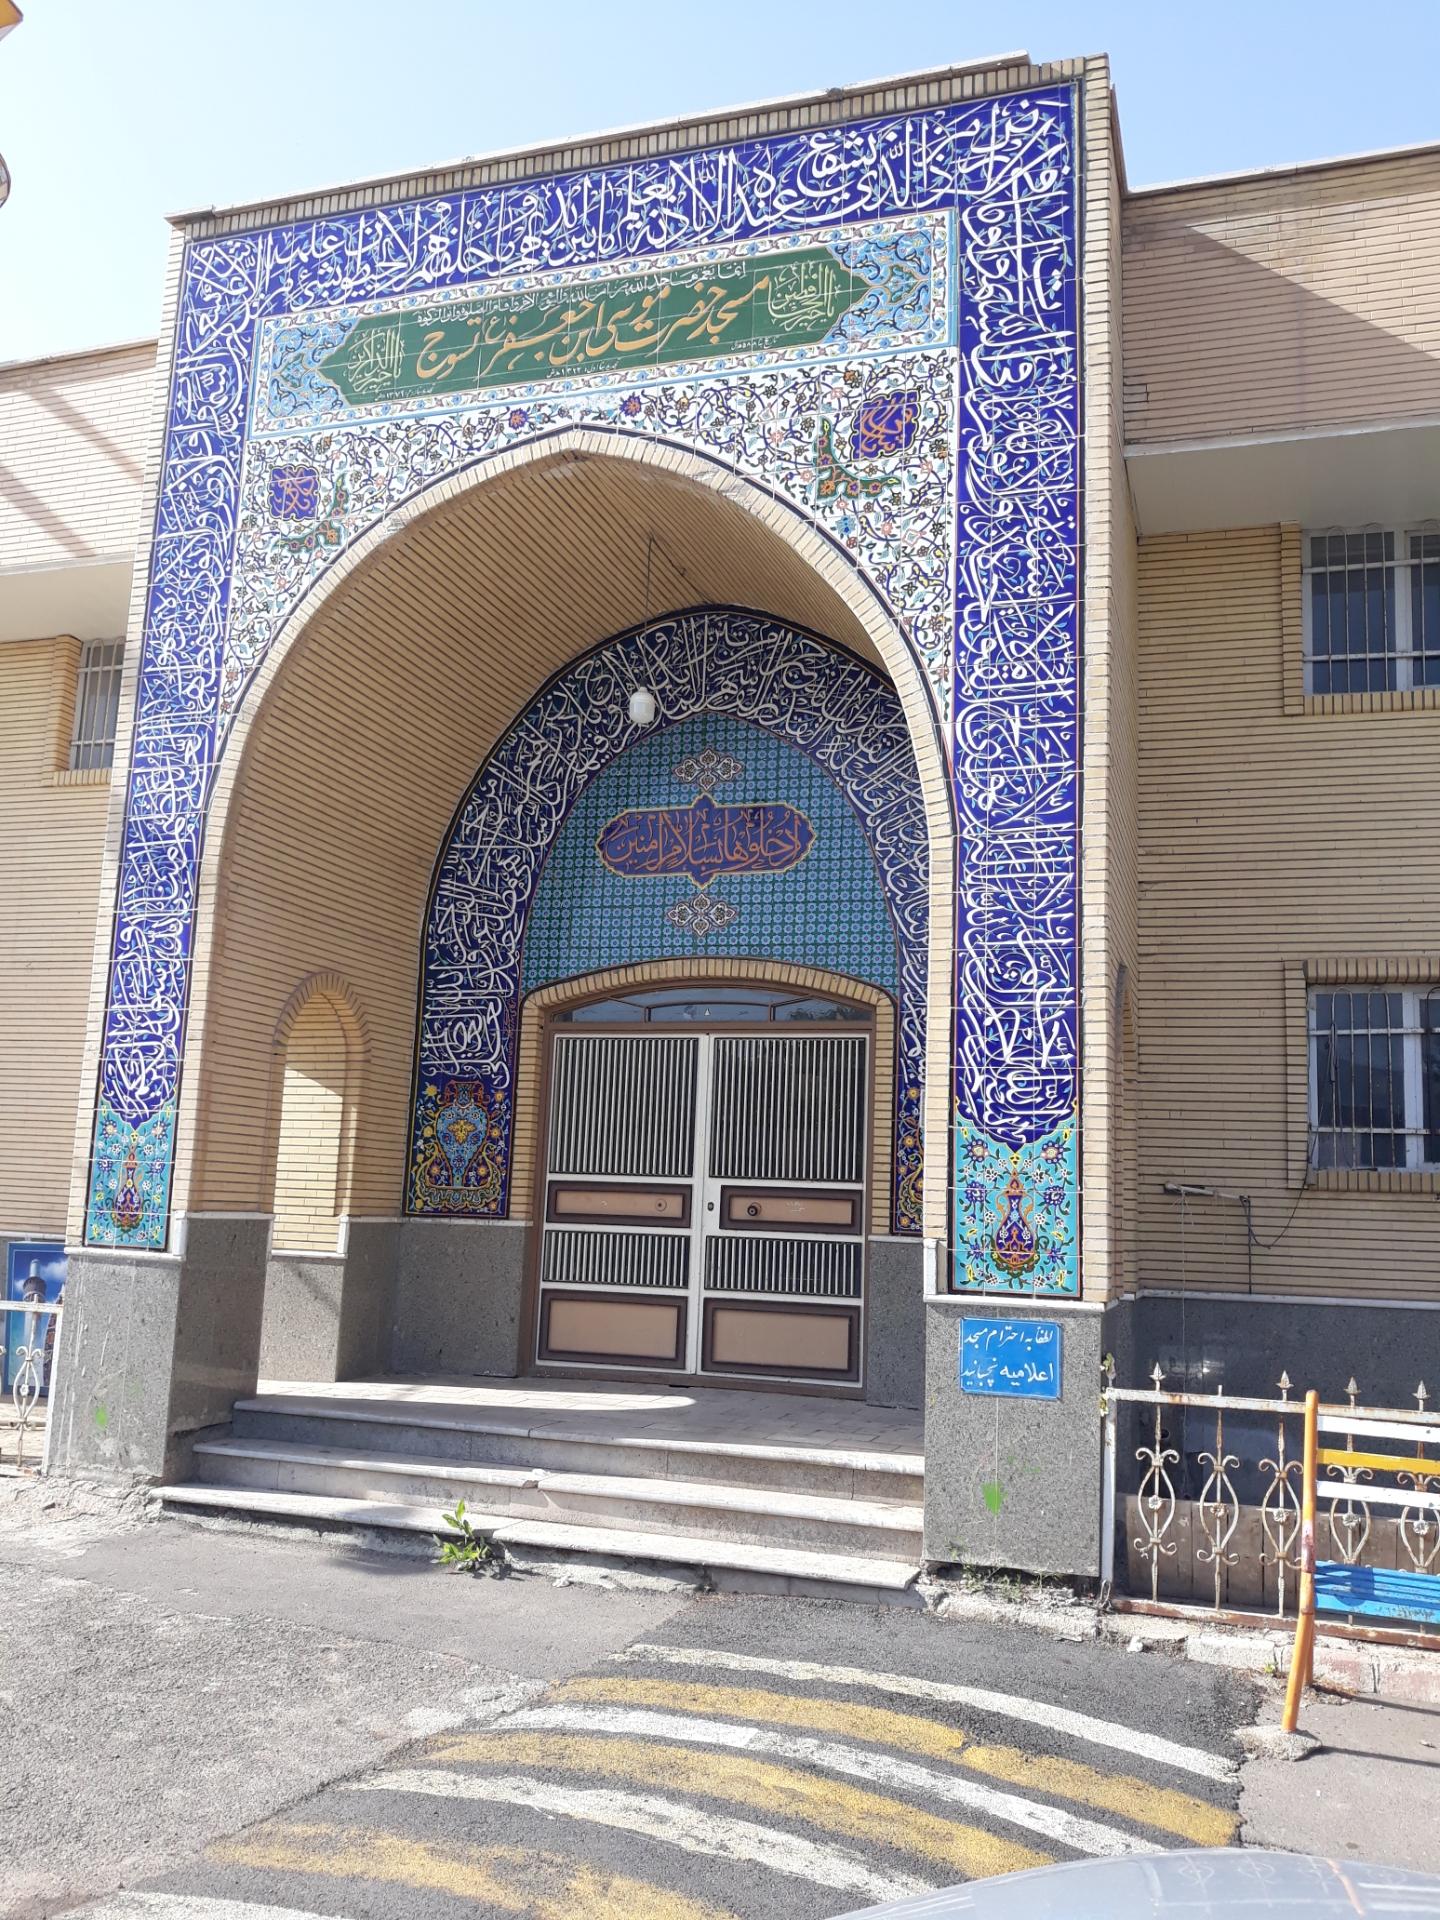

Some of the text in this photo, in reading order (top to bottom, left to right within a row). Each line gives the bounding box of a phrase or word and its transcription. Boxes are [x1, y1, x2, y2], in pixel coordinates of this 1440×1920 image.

[477, 299, 598, 380] جعفر
[548, 300, 606, 366] ابن
[614, 282, 729, 358] حضرت
[687, 275, 769, 345] مسجد
[964, 1327, 989, 1350] مسجد
[985, 1325, 1024, 1352] احترام
[1000, 1362, 1054, 1387] اعلامیه
